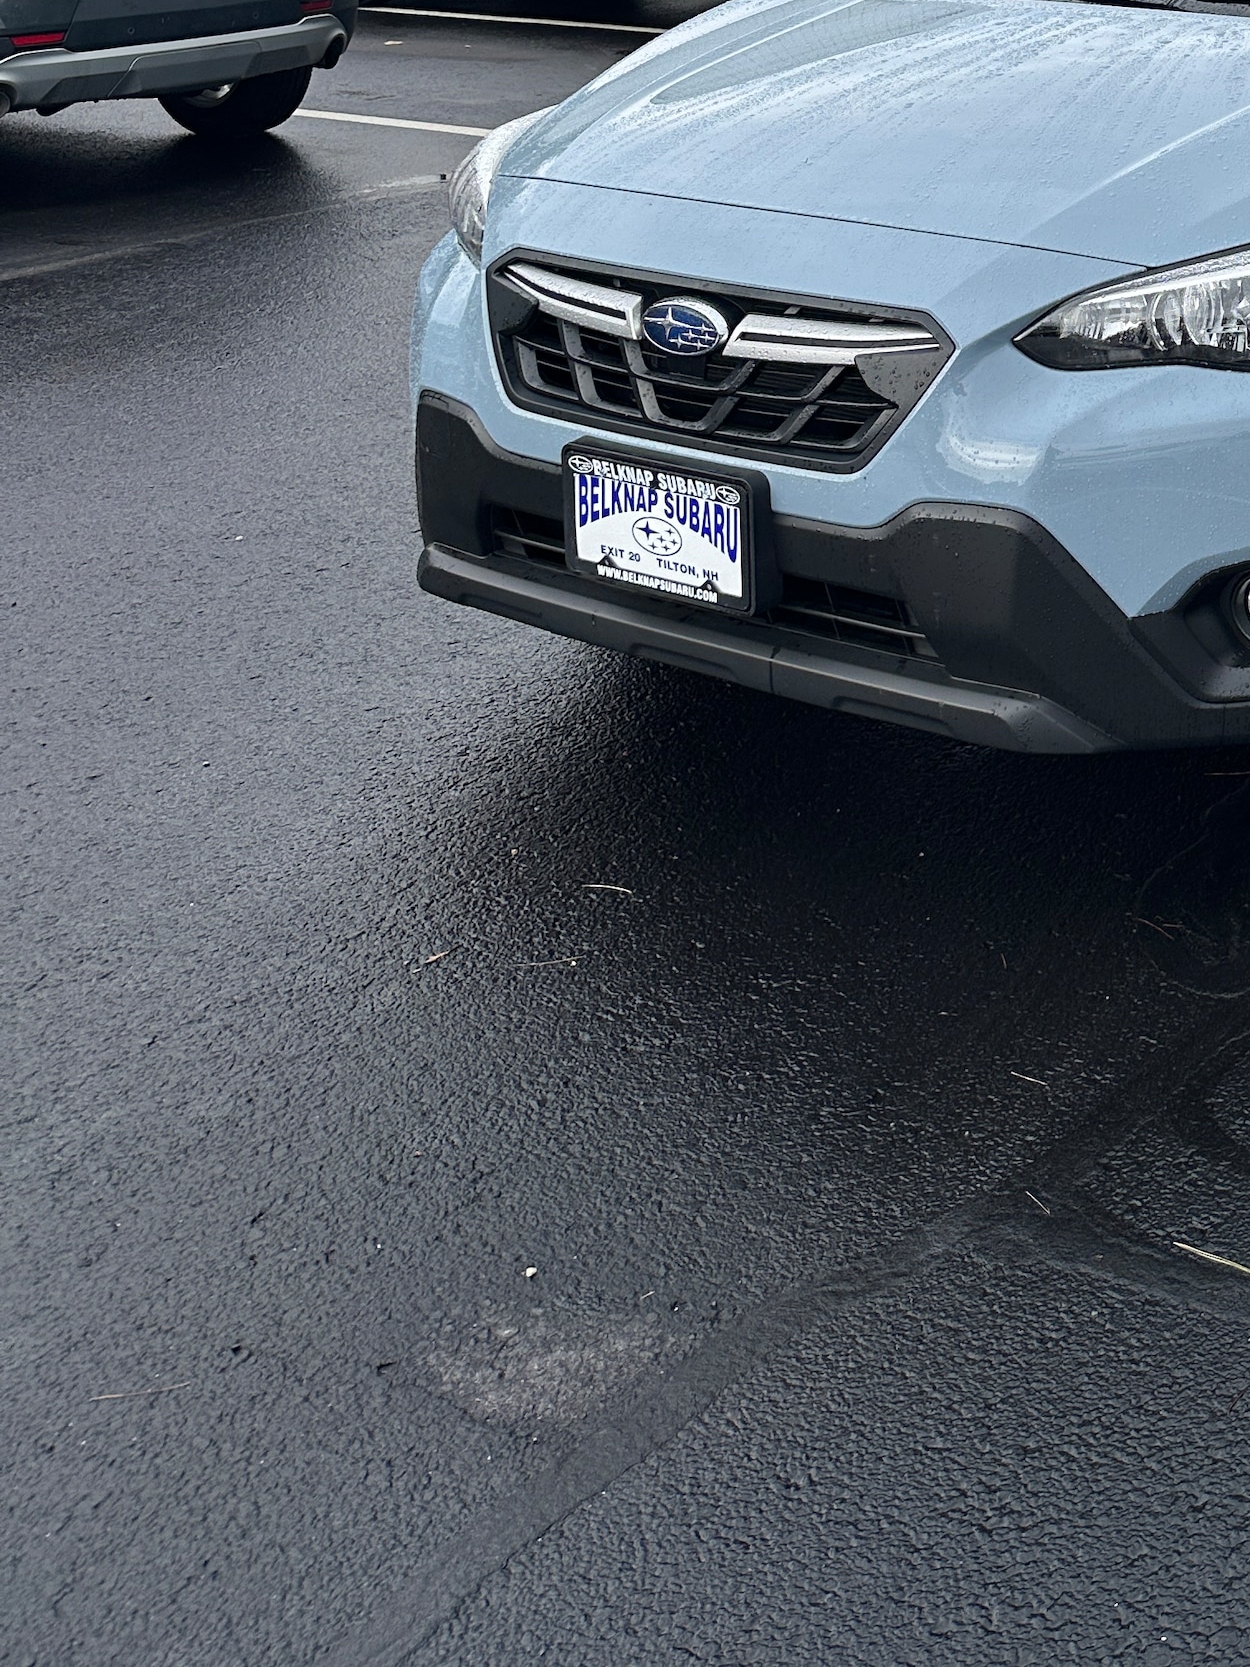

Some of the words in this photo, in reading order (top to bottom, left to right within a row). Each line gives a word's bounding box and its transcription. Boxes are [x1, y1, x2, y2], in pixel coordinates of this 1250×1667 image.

[592, 459, 654, 486] BELKNAP
[657, 473, 716, 500] SUBARU
[578, 474, 658, 527] BELKNAP
[664, 492, 738, 564] SUBARU
[600, 545, 625, 557] EXIT
[628, 551, 641, 562] 20
[656, 558, 699, 579] TILTON,
[702, 569, 719, 582] NH
[596, 564, 718, 604] WWW.BELKNAPSUBARU.COM
